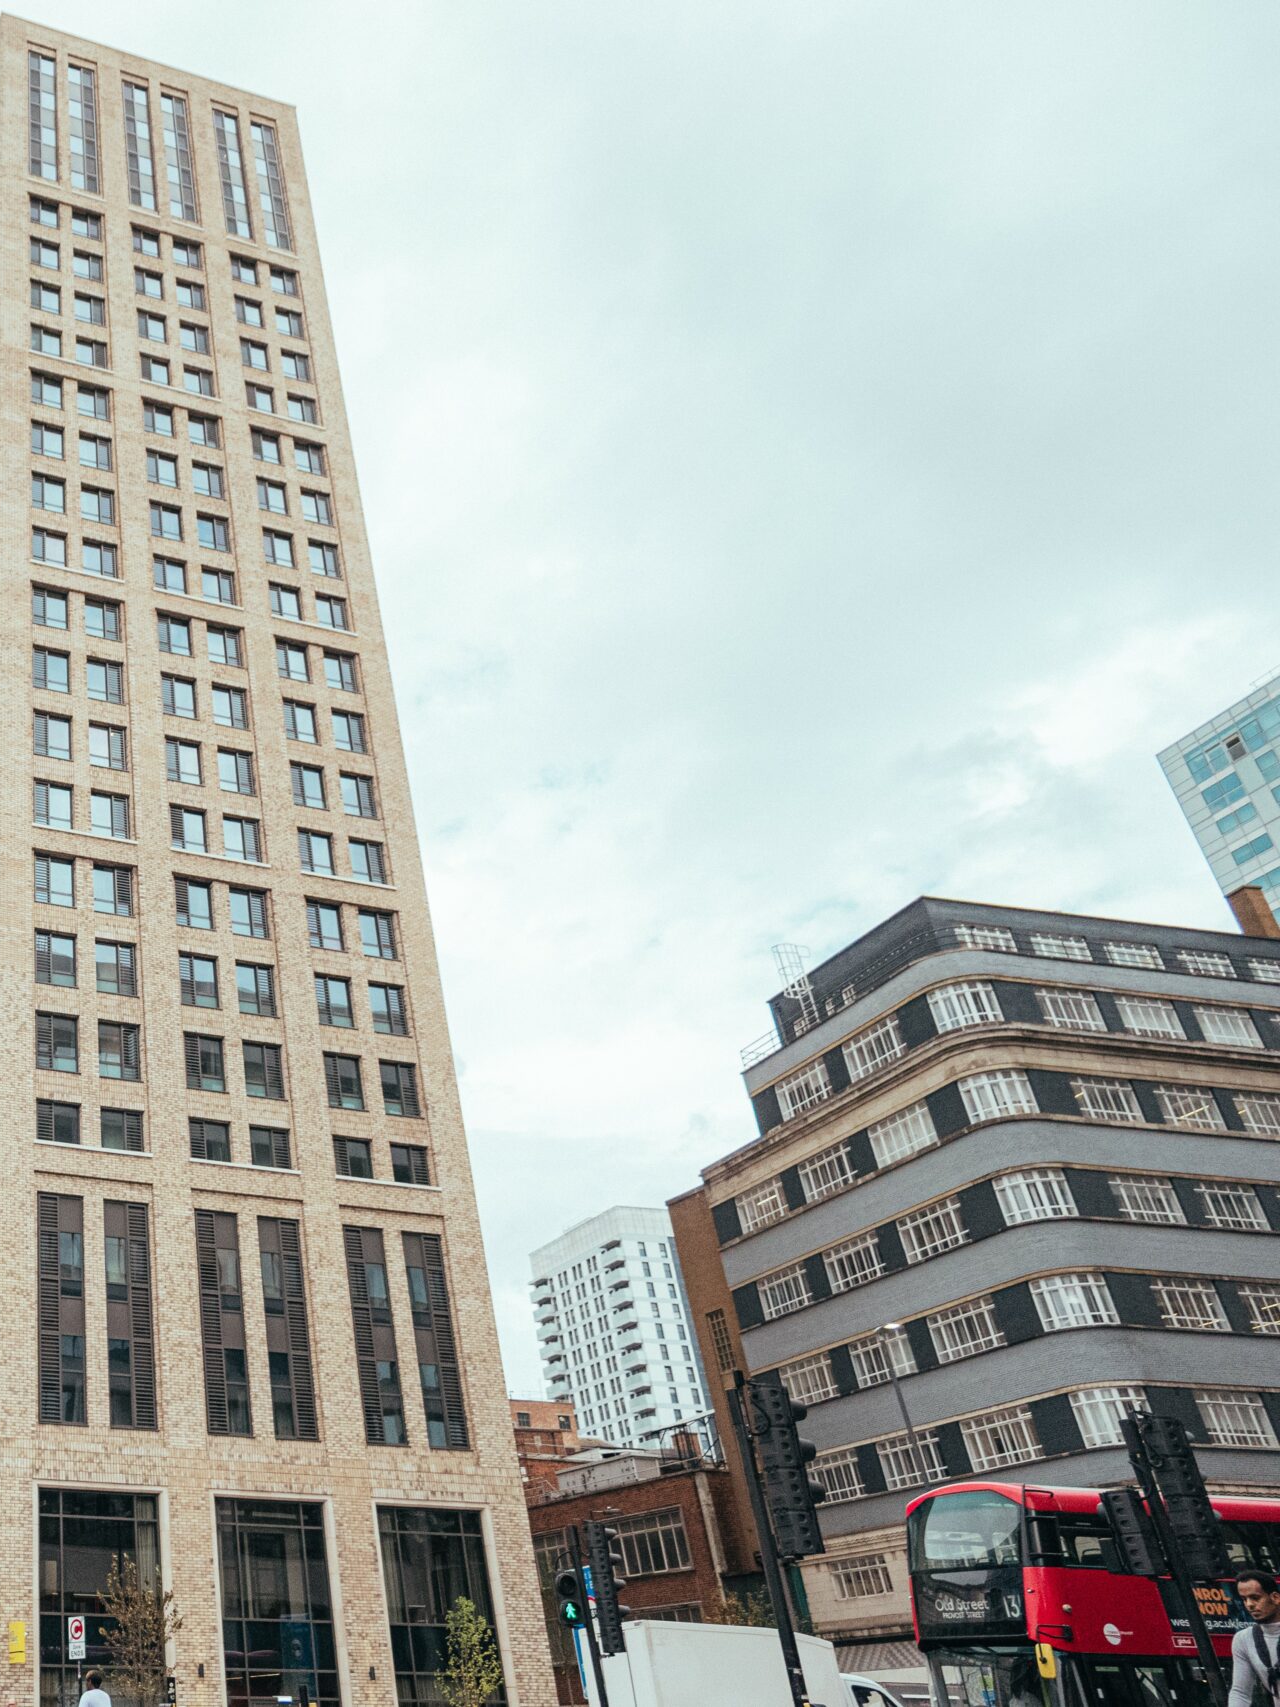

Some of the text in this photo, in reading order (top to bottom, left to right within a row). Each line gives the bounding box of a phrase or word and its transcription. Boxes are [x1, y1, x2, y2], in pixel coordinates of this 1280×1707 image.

[1192, 1587, 1232, 1601] NROL
[935, 1598, 990, 1612] Old Street
[965, 1611, 985, 1619] STREET
